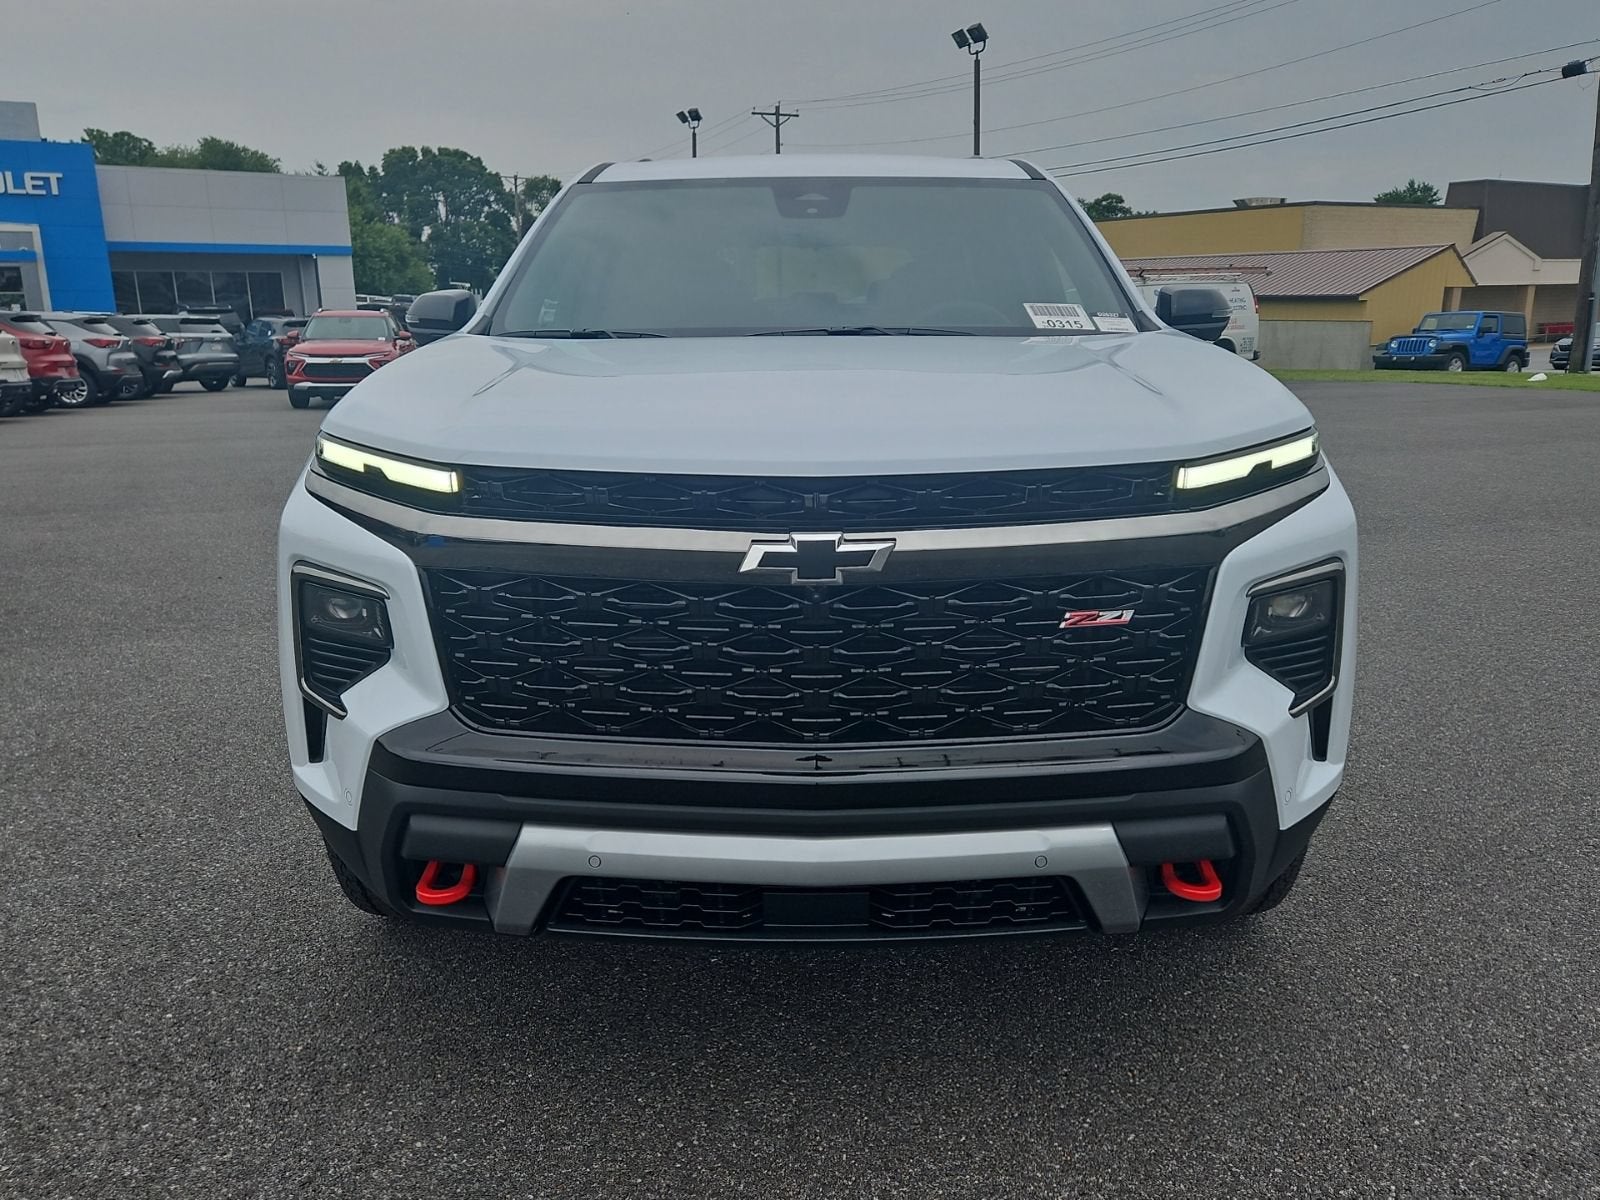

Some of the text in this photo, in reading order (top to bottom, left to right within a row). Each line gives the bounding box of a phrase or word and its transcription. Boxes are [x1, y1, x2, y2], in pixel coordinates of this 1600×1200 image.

[0, 171, 63, 195] LET
[1046, 319, 1084, 329] 0315
[1059, 609, 1135, 629] Z71
